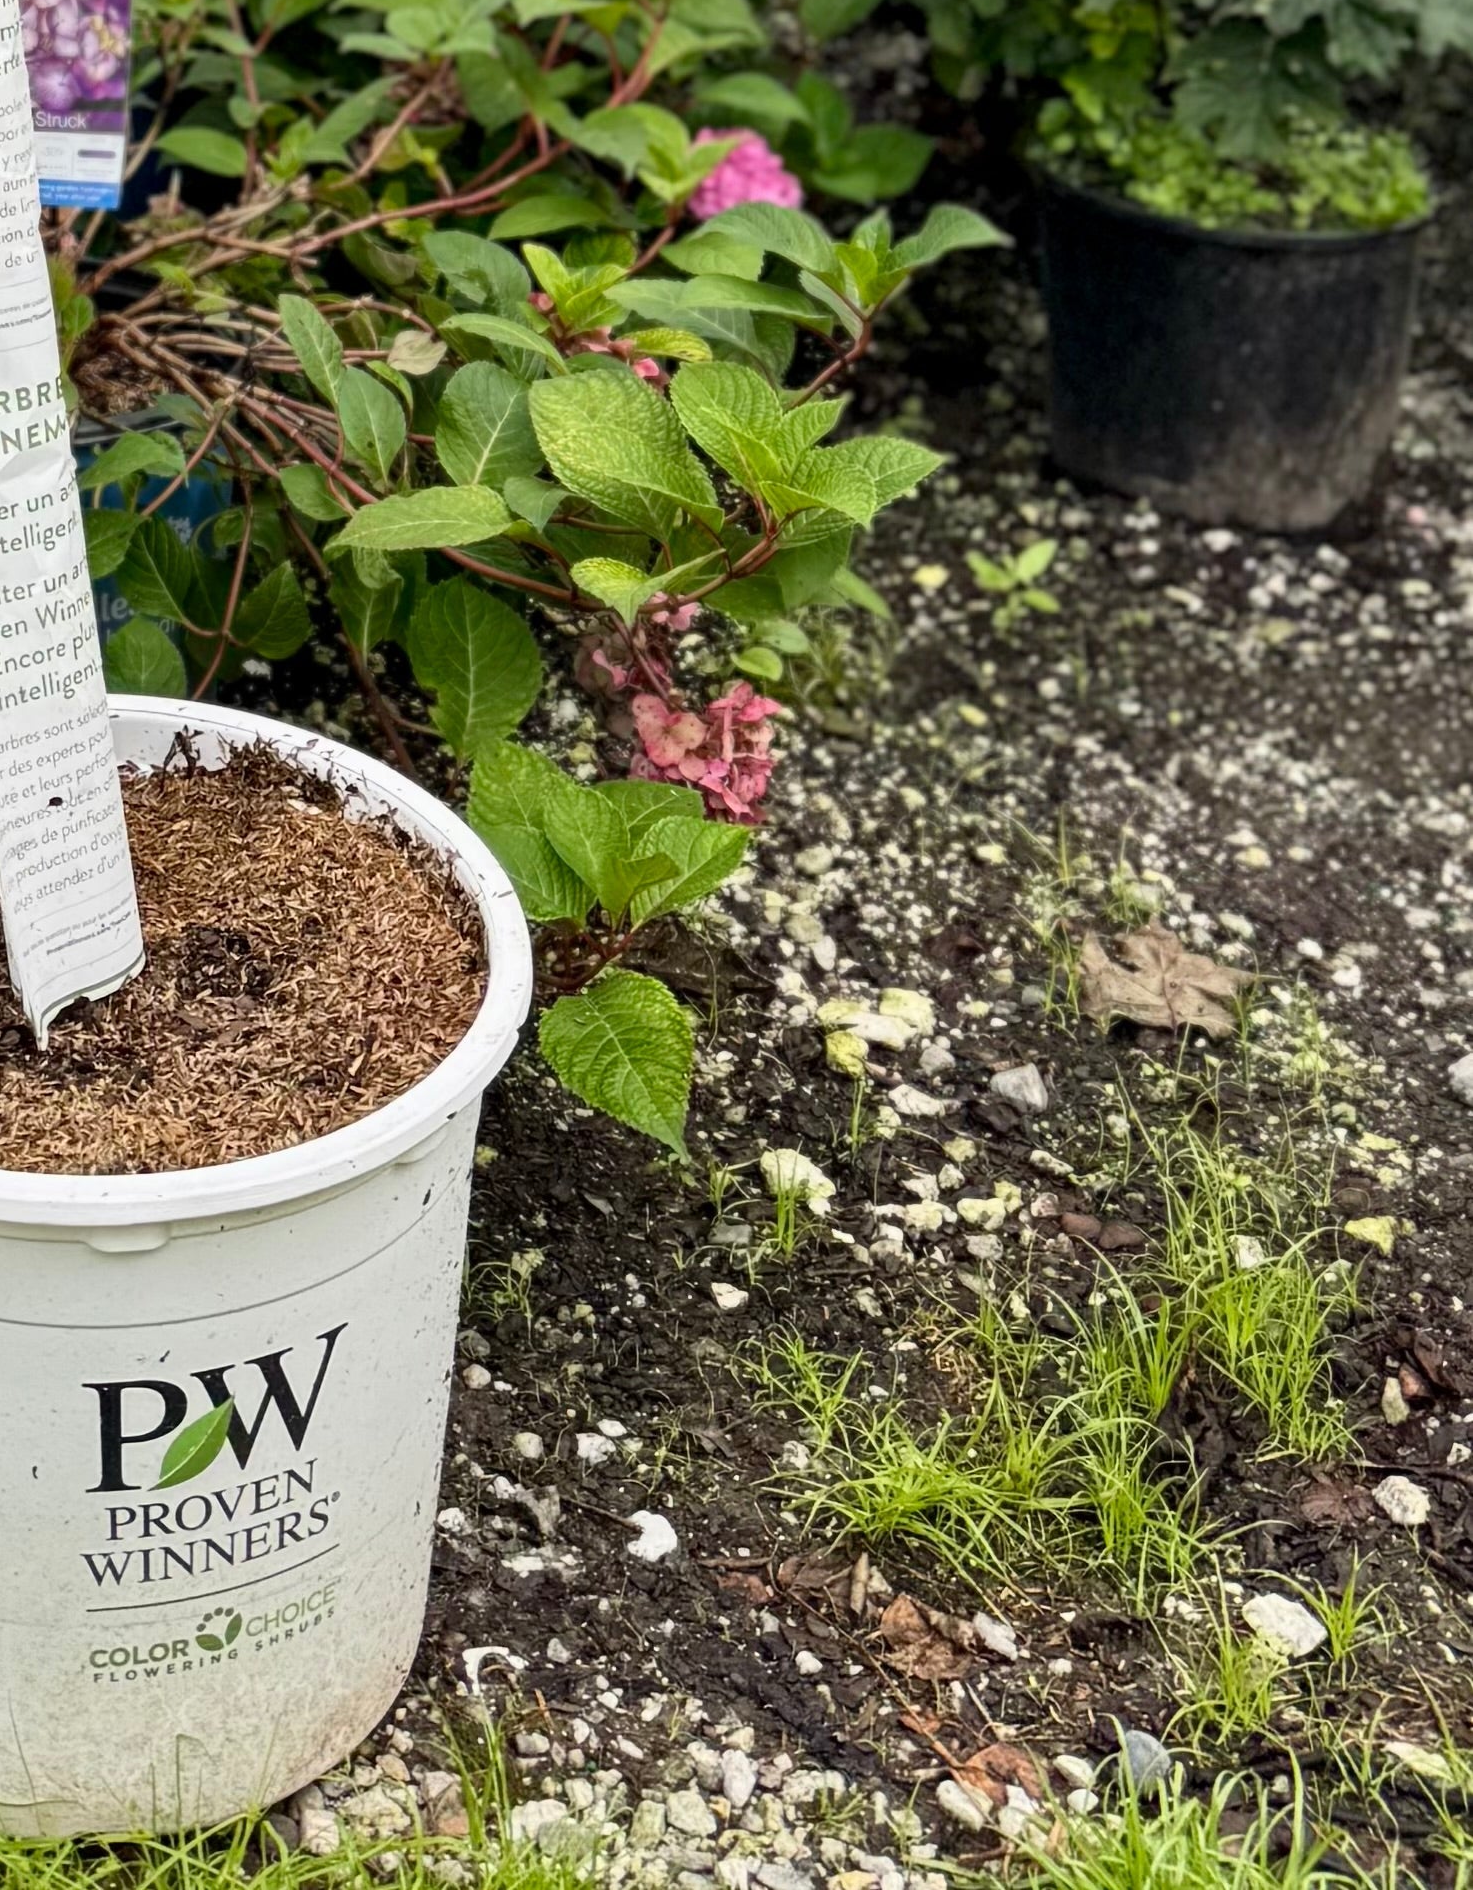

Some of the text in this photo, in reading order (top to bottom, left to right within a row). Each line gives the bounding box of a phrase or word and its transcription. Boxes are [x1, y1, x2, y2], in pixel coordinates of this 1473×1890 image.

[0, 202, 17, 219] de
[4, 251, 22, 268] de
[27, 493, 53, 512] un
[44, 573, 67, 593] un
[44, 719, 74, 739] sont
[9, 759, 33, 777] des
[36, 742, 86, 768] experts
[39, 772, 73, 792] leurs
[41, 827, 58, 845] de
[16, 844, 88, 888] production
[36, 868, 93, 900] attendez
[81, 1322, 349, 1493] PW
[105, 1458, 318, 1541] PROVEN
[89, 1583, 337, 1669] COLOR CHOICE
[93, 1607, 335, 1683] FLOWERING SHRUBS
